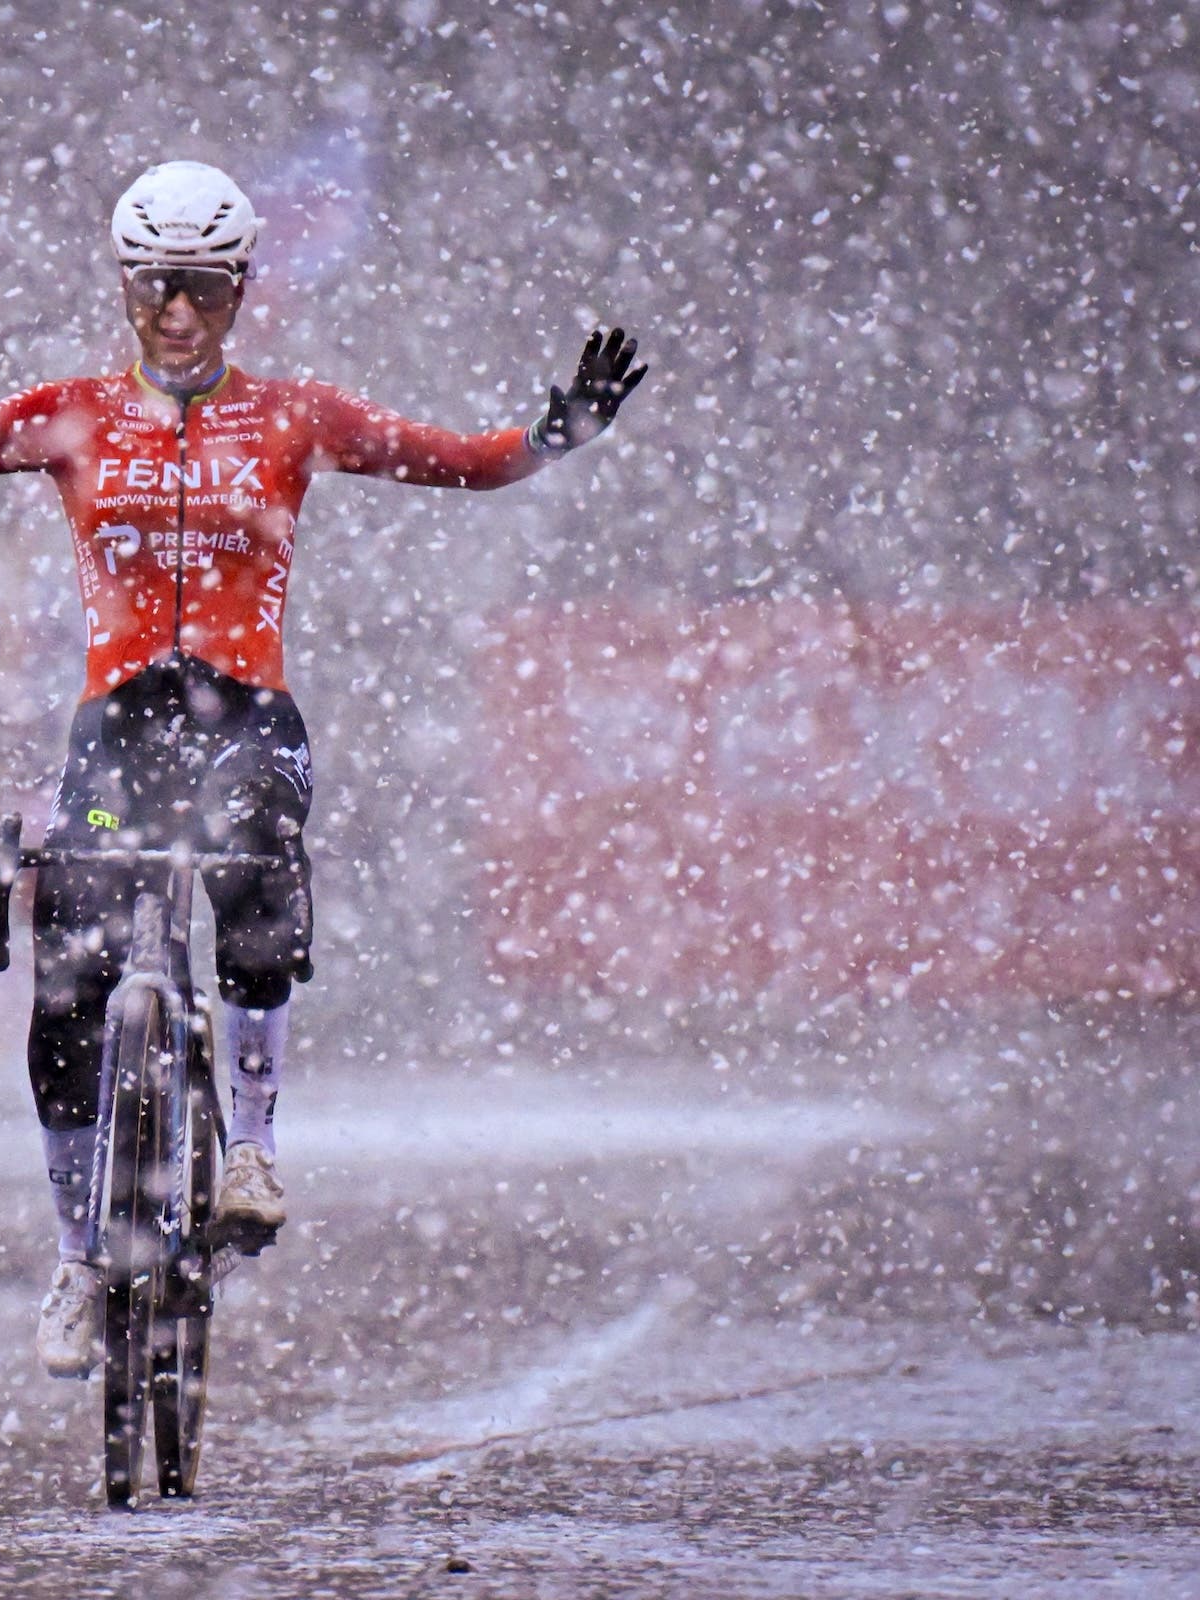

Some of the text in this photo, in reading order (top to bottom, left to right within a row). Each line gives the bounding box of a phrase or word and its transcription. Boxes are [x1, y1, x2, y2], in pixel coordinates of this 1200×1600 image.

[97, 456, 264, 491] FENIX
[95, 493, 267, 510] INNOVATIVE MATERIALS
[150, 530, 251, 553] PREMIER
[153, 549, 214, 568] TECH
[255, 513, 297, 634] FENIX
